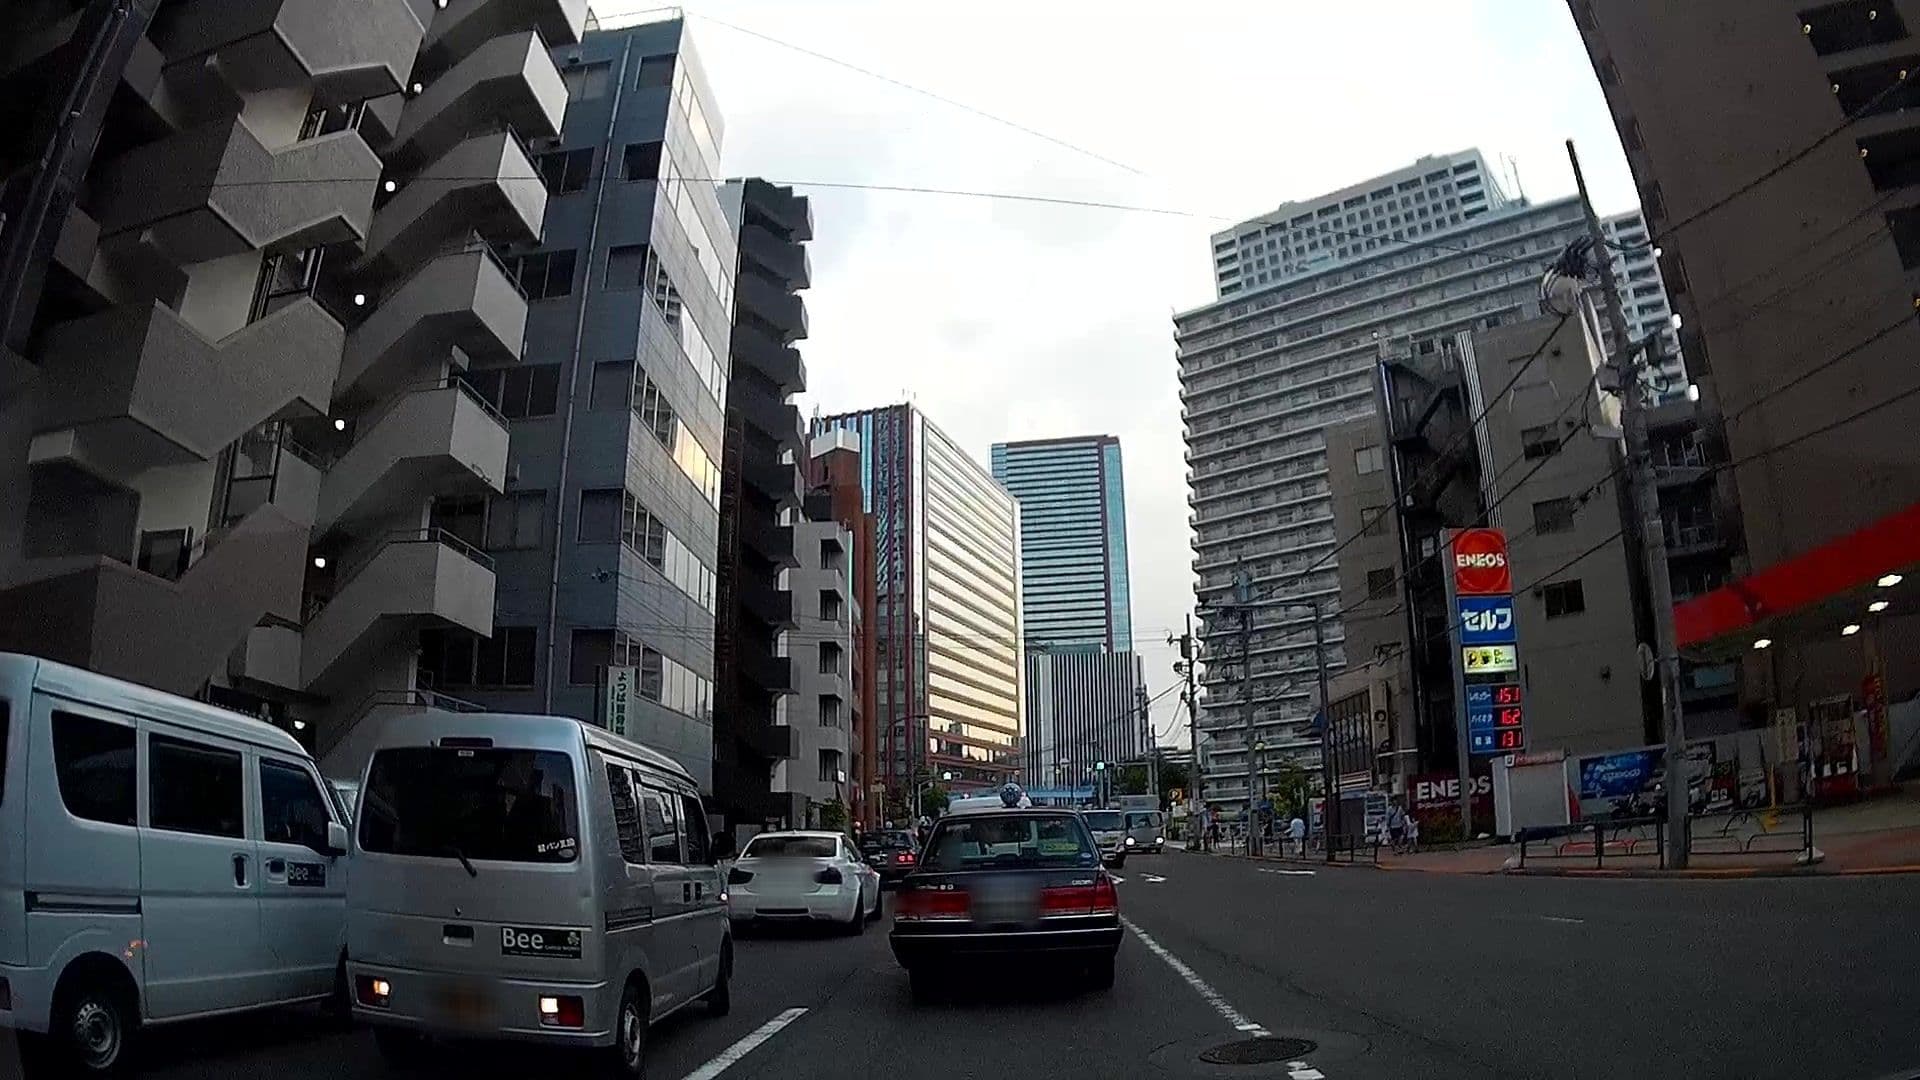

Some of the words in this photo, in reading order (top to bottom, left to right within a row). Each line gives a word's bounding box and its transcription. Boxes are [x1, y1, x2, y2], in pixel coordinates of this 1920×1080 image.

[1456, 553, 1505, 567] ENEOS
[1461, 607, 1512, 631] セルフ
[1500, 687, 1520, 703] 151
[1503, 731, 1522, 747] 131
[287, 863, 309, 881] Bee
[502, 927, 544, 949] Bee
